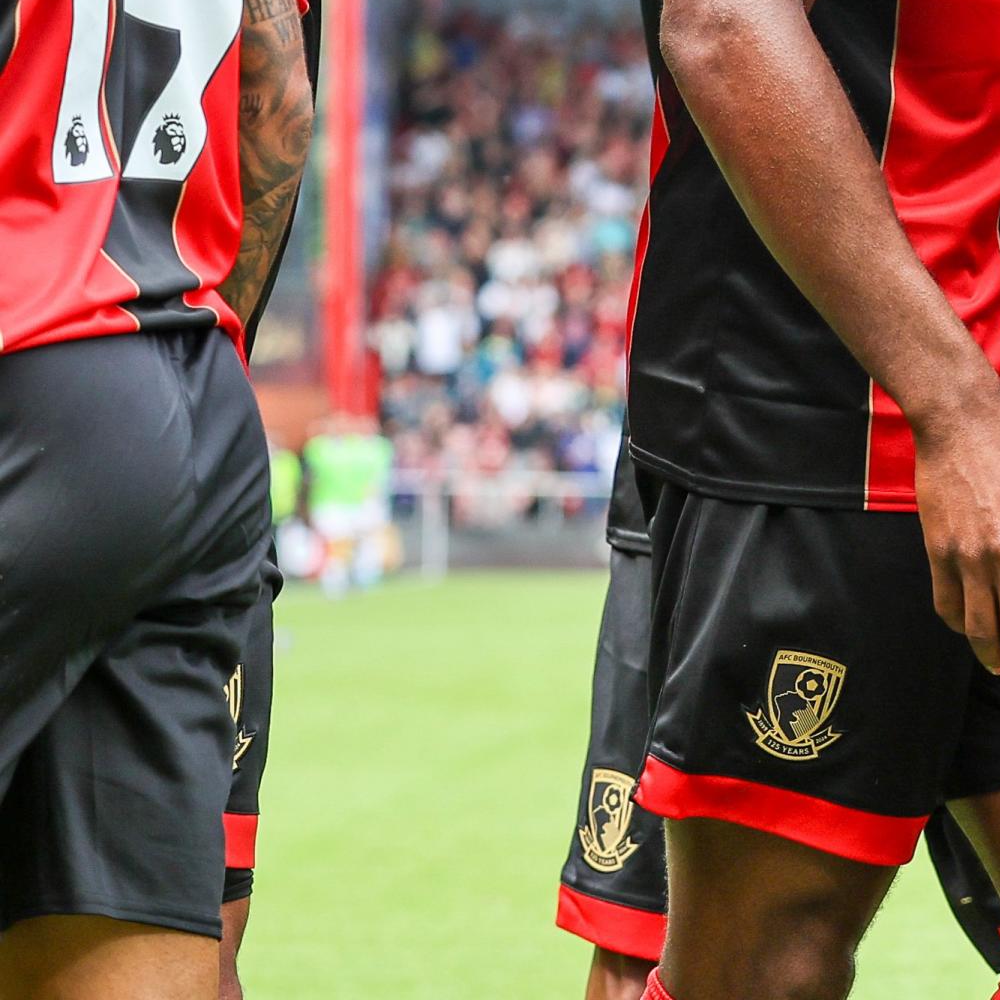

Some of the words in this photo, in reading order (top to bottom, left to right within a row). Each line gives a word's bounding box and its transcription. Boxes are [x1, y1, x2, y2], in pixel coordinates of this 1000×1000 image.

[793, 655, 845, 675] BOURNEMOUTH
[767, 739, 780, 751] 125
[782, 745, 811, 756] YEARS
